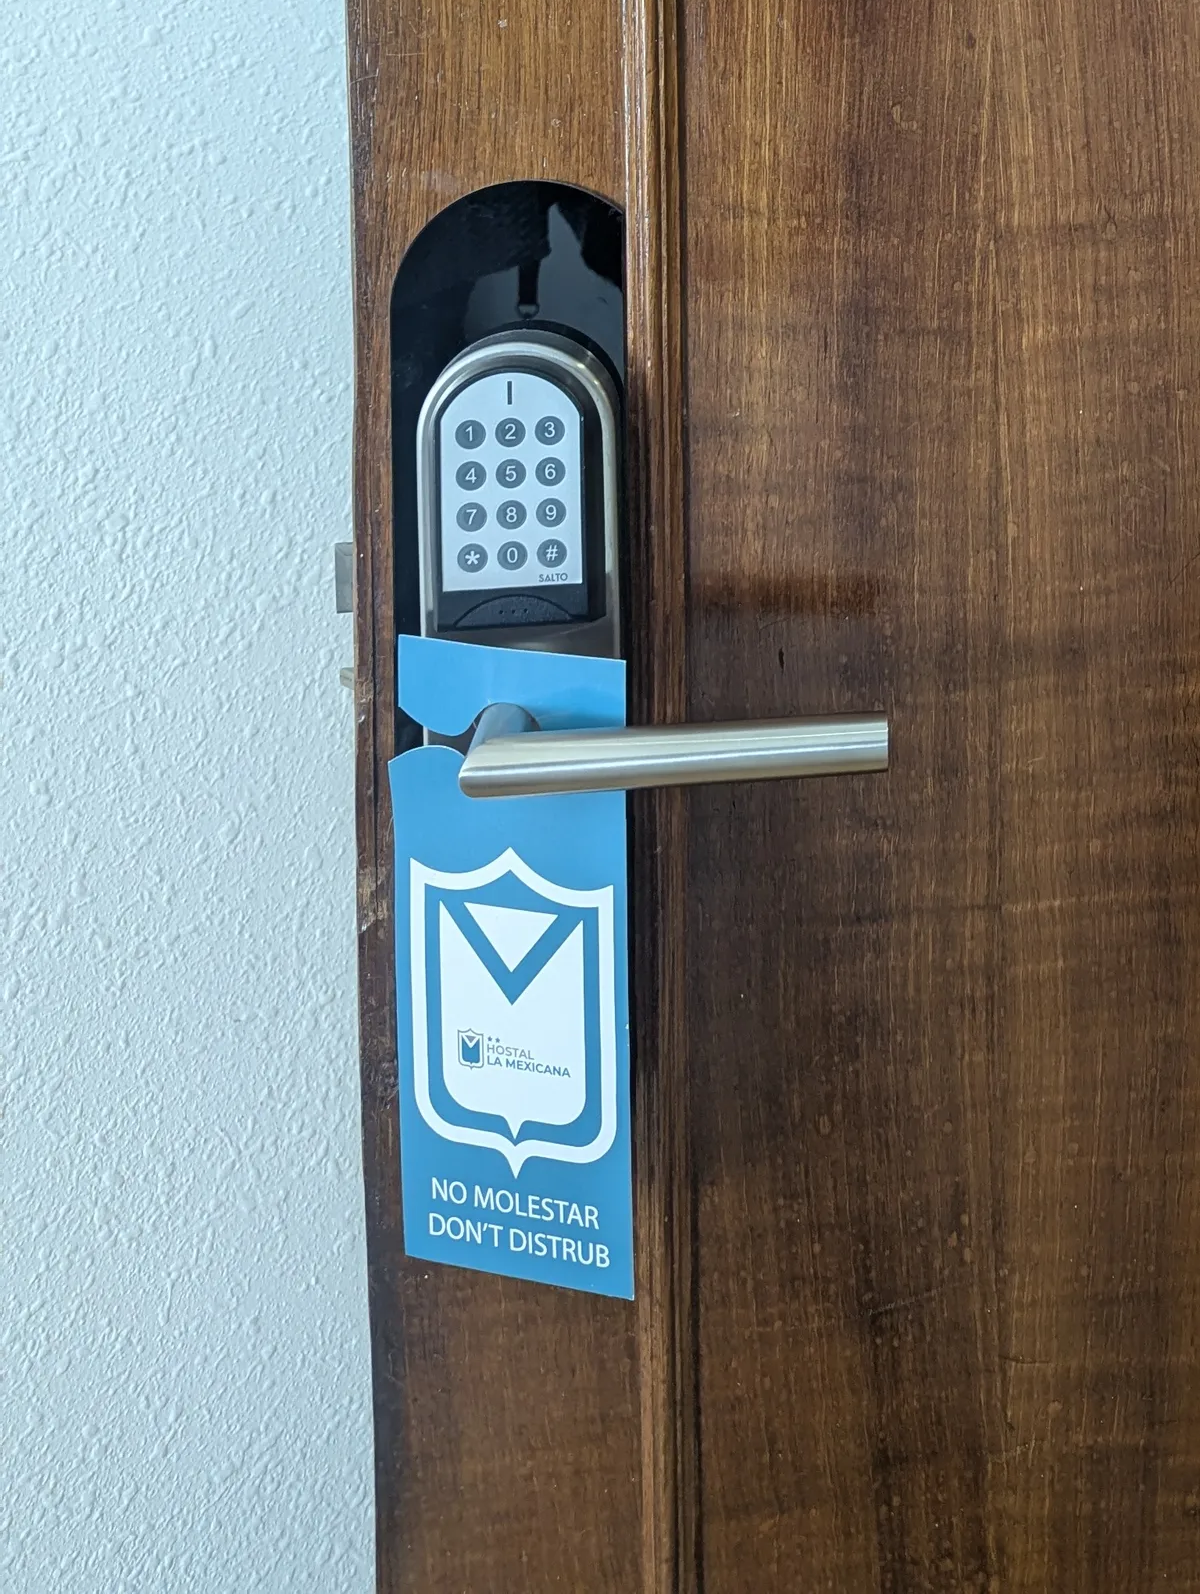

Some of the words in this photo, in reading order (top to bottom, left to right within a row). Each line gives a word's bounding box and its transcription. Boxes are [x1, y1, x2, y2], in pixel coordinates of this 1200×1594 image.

[464, 426, 474, 442] 1
[504, 424, 516, 440] 2
[544, 422, 556, 438] 3
[465, 468, 477, 484] 4
[504, 466, 517, 482] 5
[544, 463, 556, 479] 6
[466, 509, 477, 525] 7
[505, 507, 517, 523] 8
[545, 504, 557, 520] 9
[507, 548, 518, 563] 0
[538, 572, 569, 583] SALTO
[486, 1042, 535, 1060] HOSTAL
[486, 1055, 503, 1067] LA
[505, 1059, 571, 1078] MEXICANA
[431, 1177, 468, 1205] NO
[474, 1184, 600, 1230] MOLESTAR
[428, 1212, 504, 1248] DON'T
[509, 1227, 610, 1268] DISTRUB
